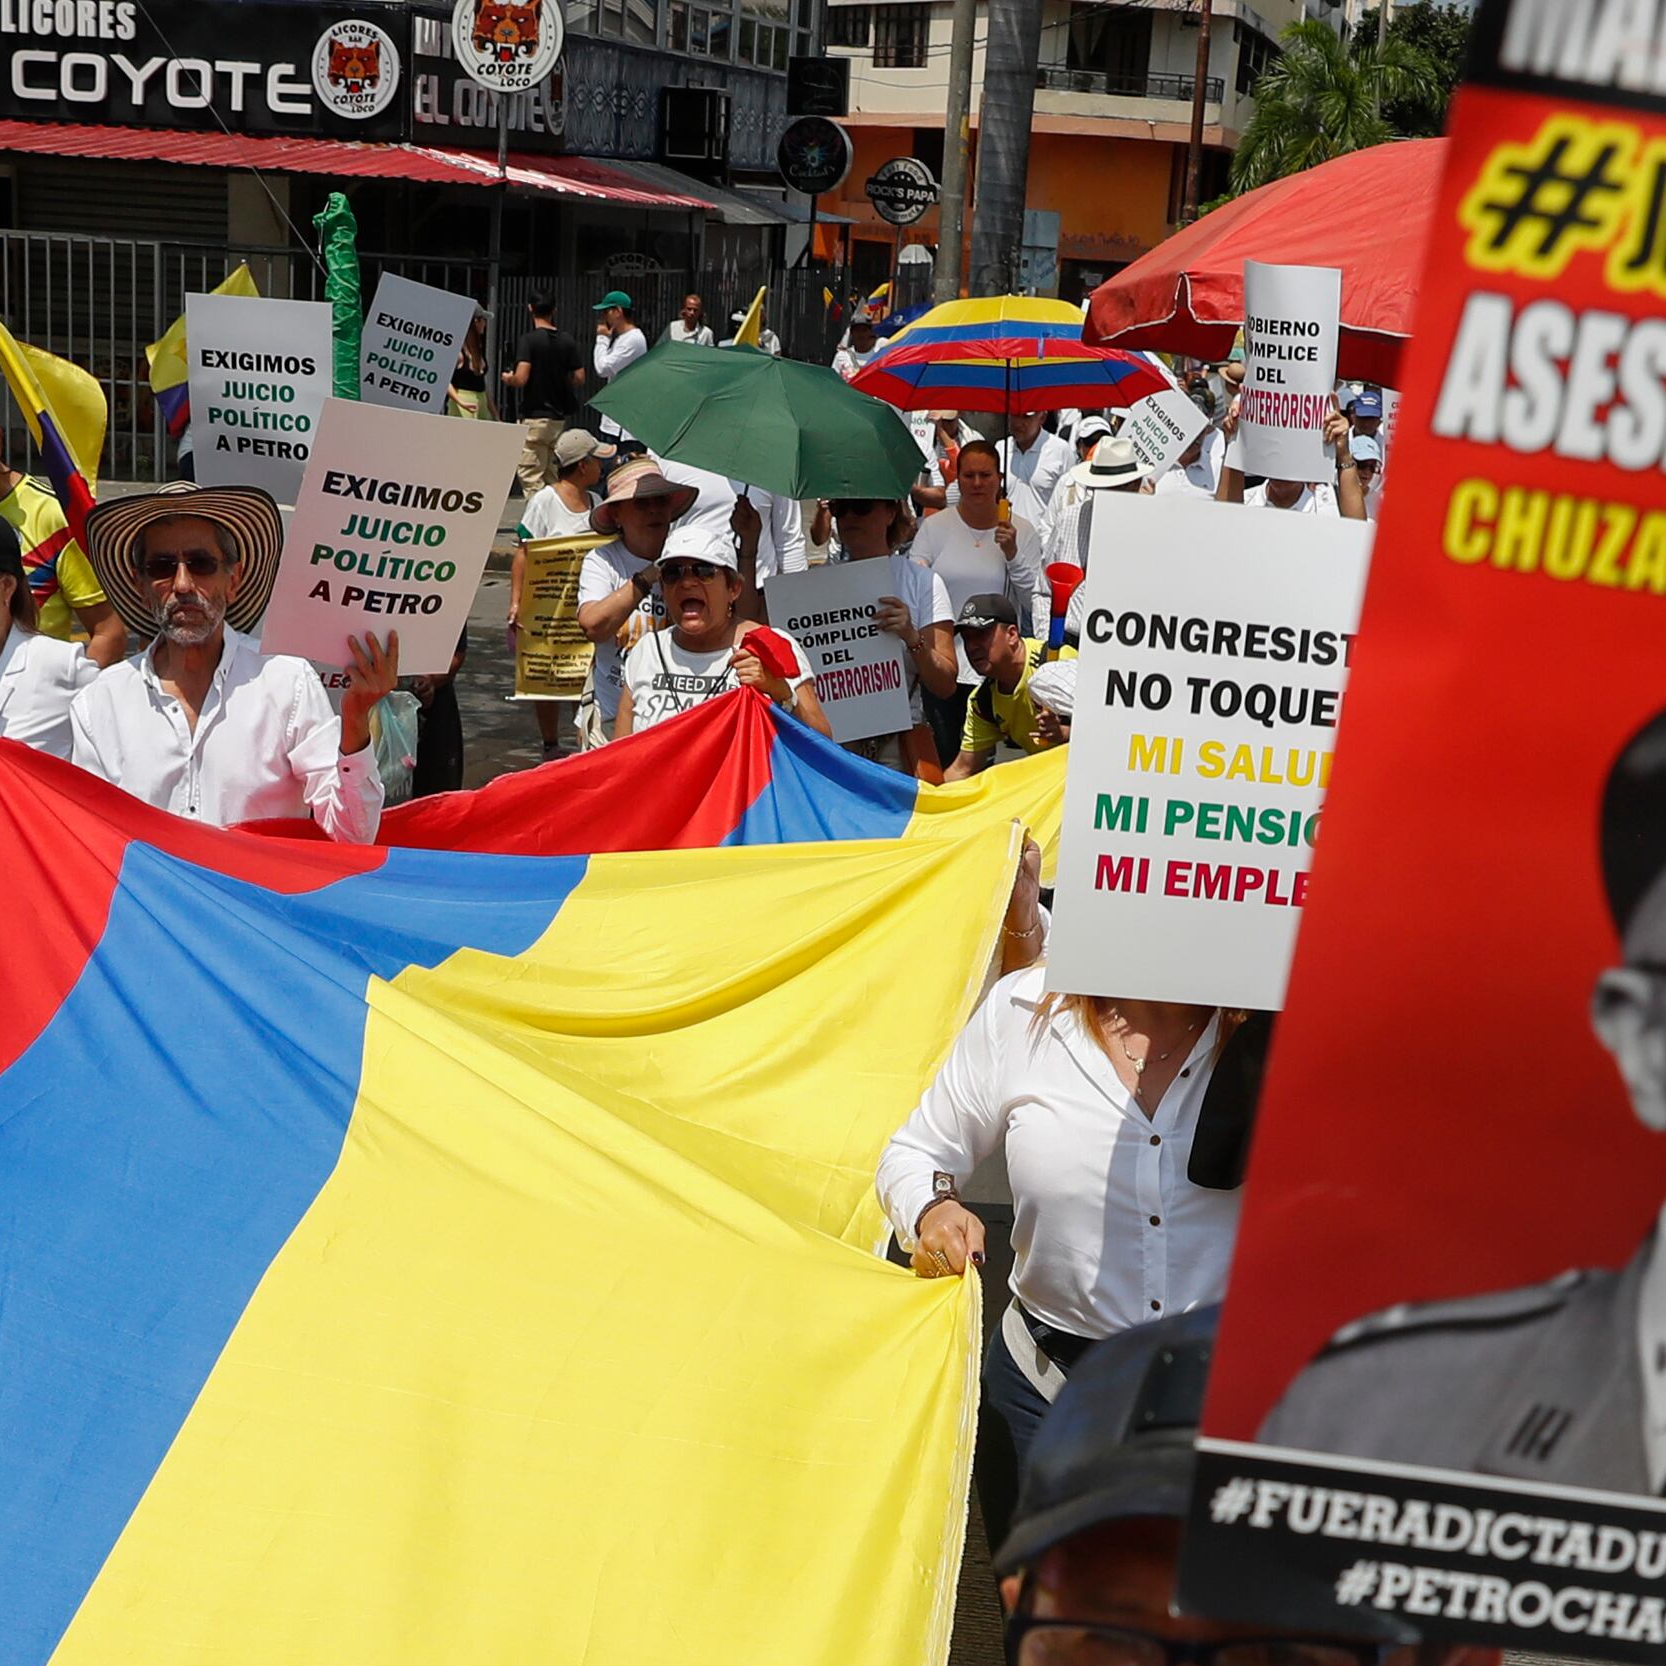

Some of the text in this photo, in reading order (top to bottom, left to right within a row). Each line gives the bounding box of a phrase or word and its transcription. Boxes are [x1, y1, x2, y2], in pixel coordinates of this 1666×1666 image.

[0, 0, 136, 40] LICORES
[332, 24, 378, 39] LICORES
[11, 49, 314, 114] COYOTE
[477, 63, 533, 75] COYOTE
[500, 78, 531, 87] LOCO
[333, 93, 376, 105] COYOTE
[351, 104, 375, 113] LOCO
[906, 189, 934, 203] PAPA
[376, 312, 454, 347] EXIGIMOS
[1248, 315, 1320, 337] OBIERNO
[200, 349, 316, 375] EXIGIMOS
[383, 337, 435, 363] JUICIO
[366, 351, 438, 384] POLÍTICO
[1256, 366, 1286, 384] DEL
[221, 380, 295, 403] JUICIO
[363, 372, 431, 403] A PETRO
[208, 406, 311, 433] POLÍTICO
[1143, 415, 1169, 445] JUICIO
[1145, 396, 1186, 441] EXIGIMOS
[216, 434, 309, 461] A PETRO
[322, 470, 484, 514] EXIGIMOS
[341, 513, 446, 547] JUICIO
[310, 543, 456, 582] POLÍTICO
[308, 579, 443, 615] A PETRO
[787, 604, 877, 631] GOBIERNO
[822, 649, 854, 666] DEL
[1104, 669, 1172, 711] NO
[1127, 733, 1184, 775] MI
[1093, 793, 1150, 834] MI
[1094, 854, 1150, 894] MI
